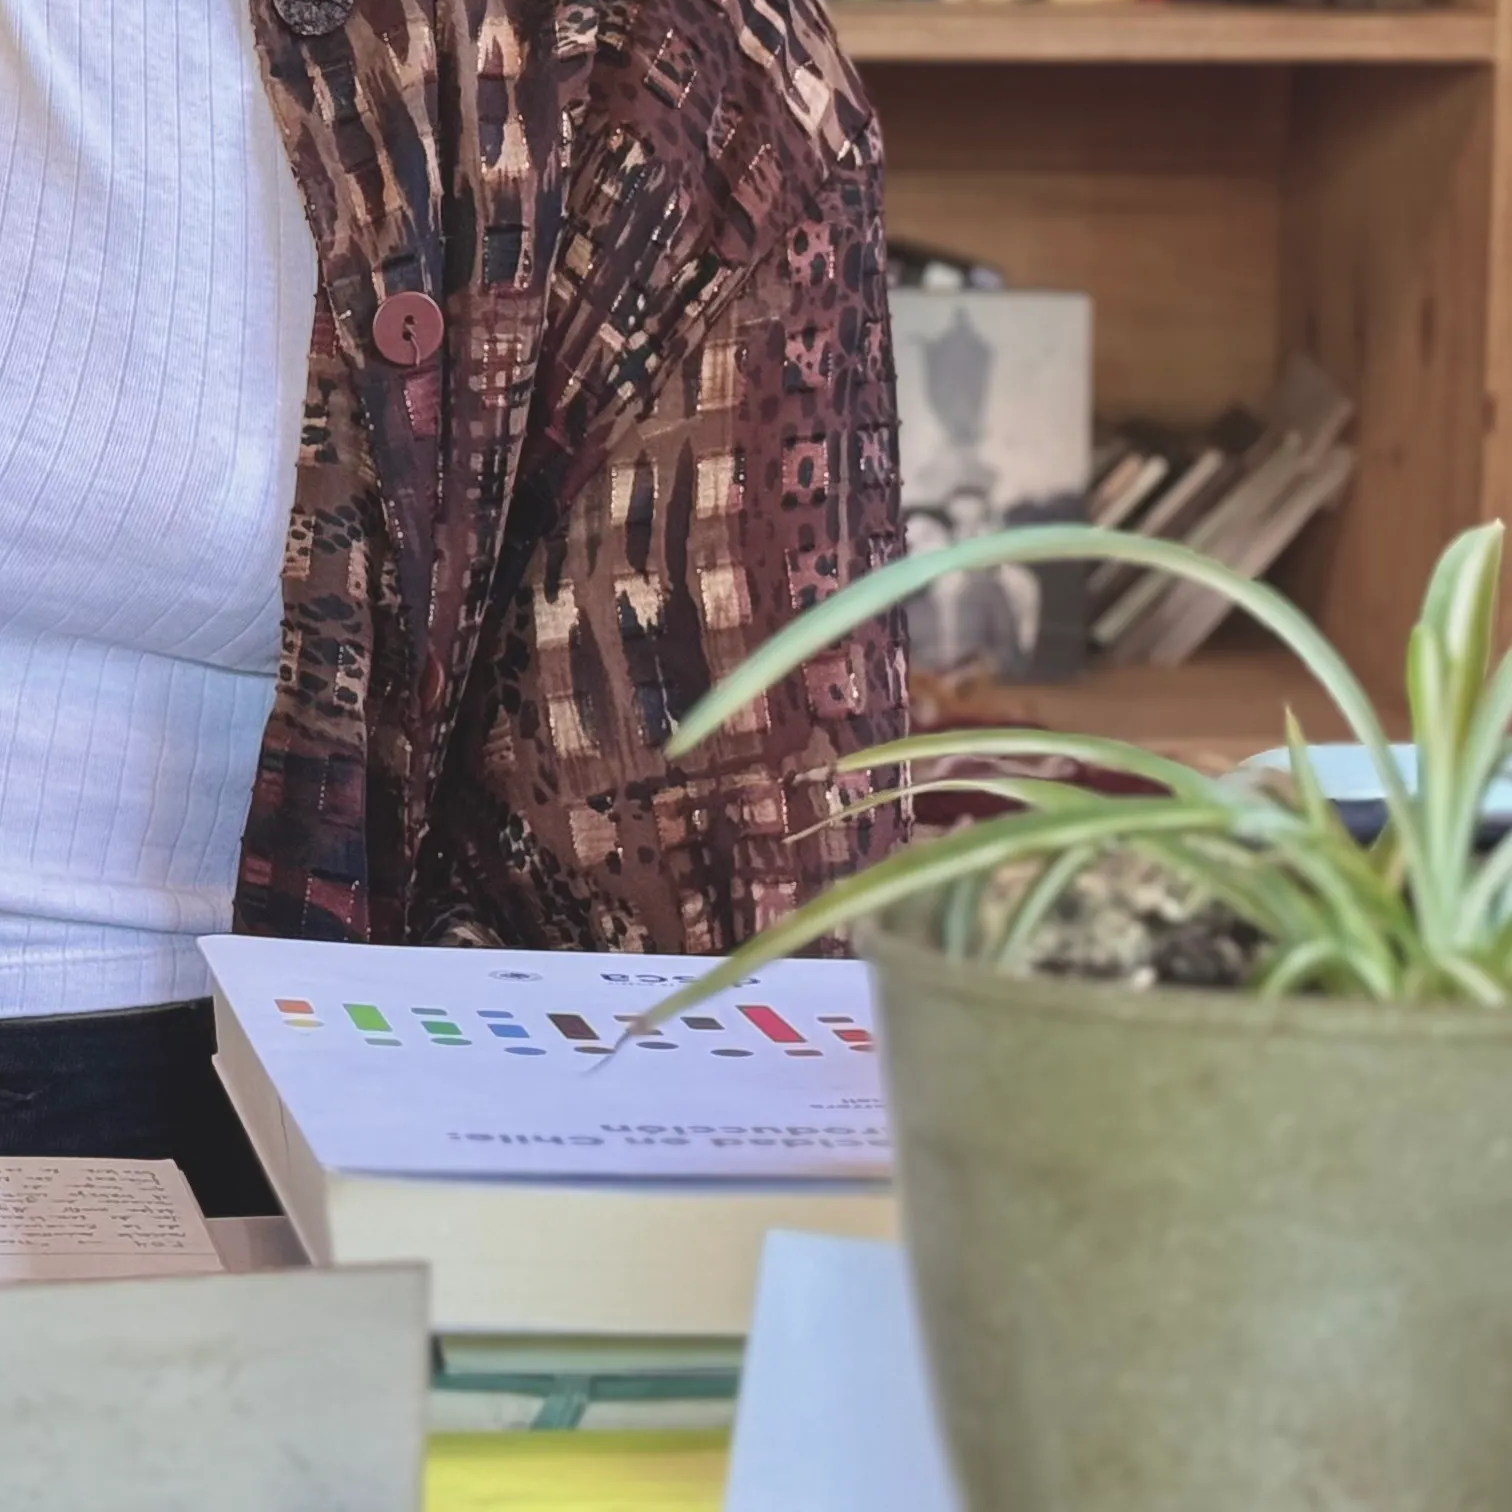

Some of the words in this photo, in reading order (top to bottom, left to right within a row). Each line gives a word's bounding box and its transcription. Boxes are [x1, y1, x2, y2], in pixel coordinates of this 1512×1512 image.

[600, 973, 760, 987] dsca
[599, 1123, 884, 1136] roducción
[447, 1131, 605, 1148] Chile:
[624, 1135, 691, 1146] en
[710, 1137, 891, 1149] acidad
